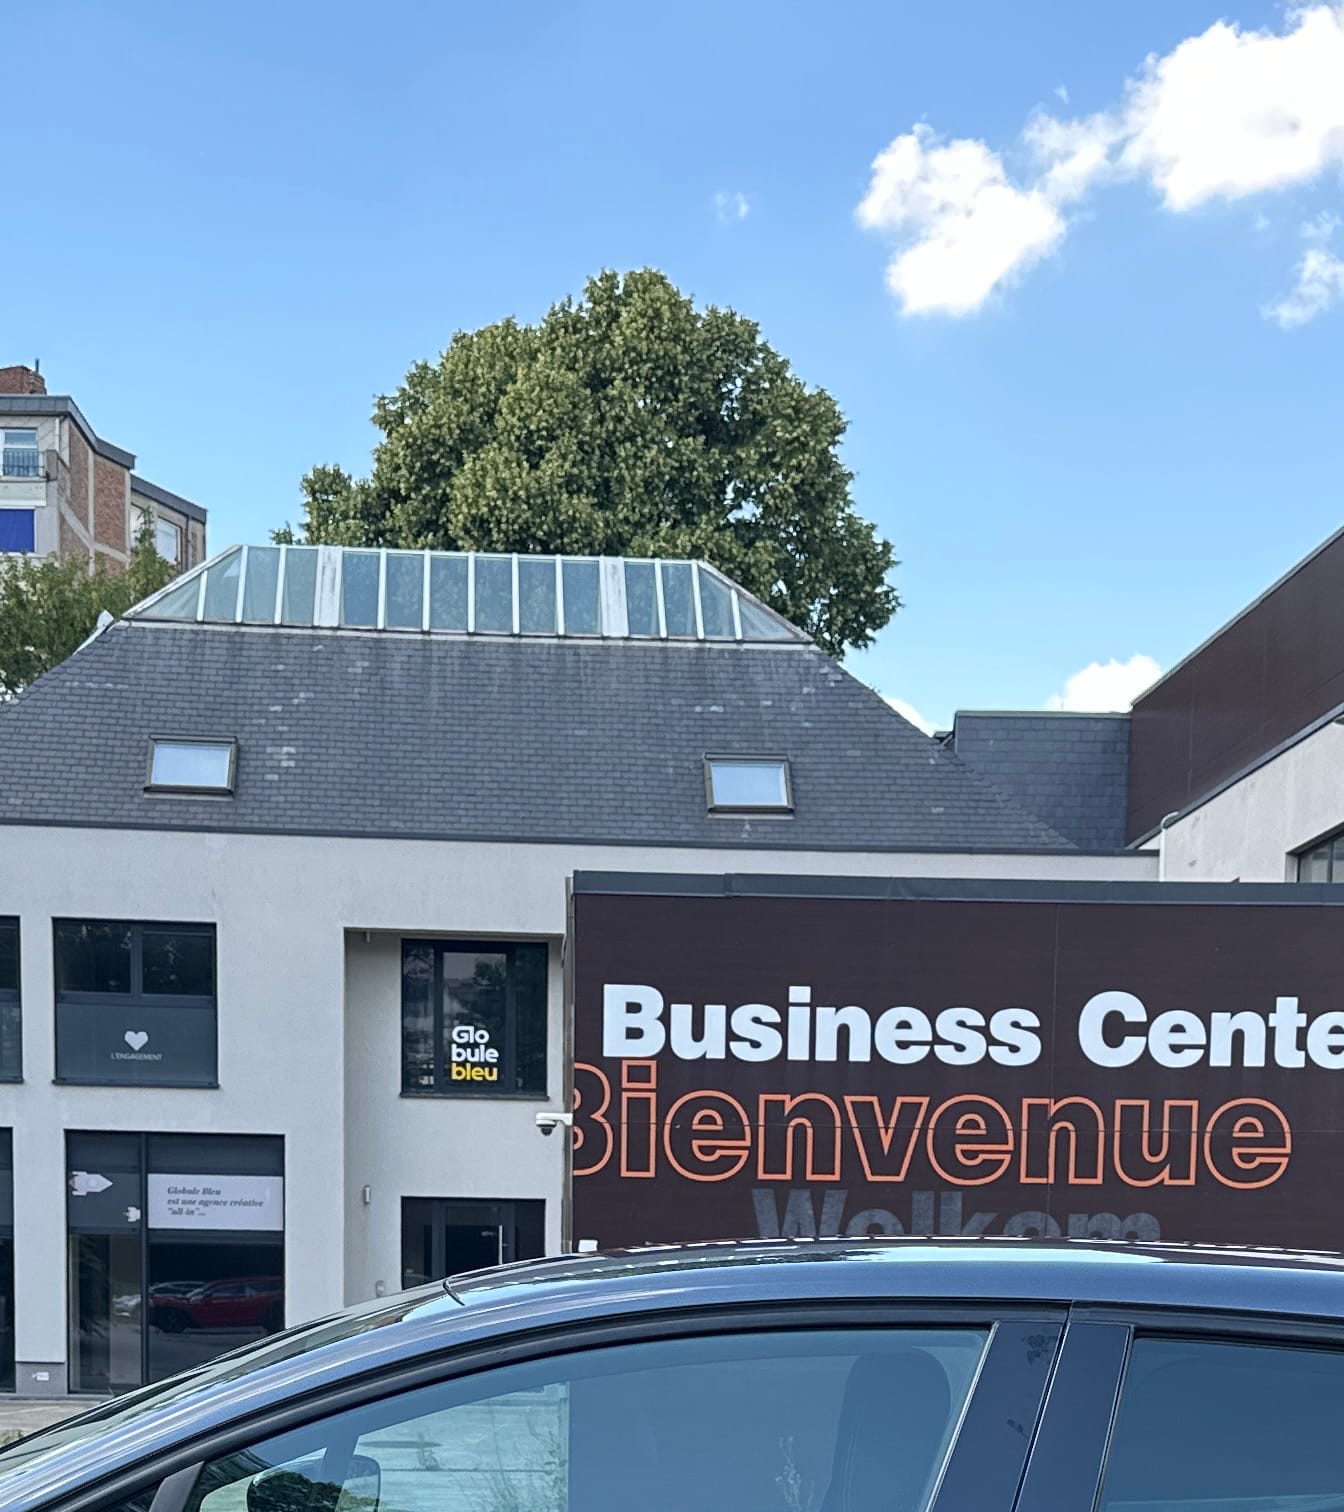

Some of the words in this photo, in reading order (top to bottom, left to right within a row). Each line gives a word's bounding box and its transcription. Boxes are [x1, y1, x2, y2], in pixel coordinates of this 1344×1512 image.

[451, 1025, 490, 1044] Glo
[602, 983, 1042, 1067] Business
[450, 1043, 500, 1063] bule
[450, 1062, 498, 1081] bleu
[167, 1186, 201, 1196] Globule
[202, 1187, 222, 1196] Bleu
